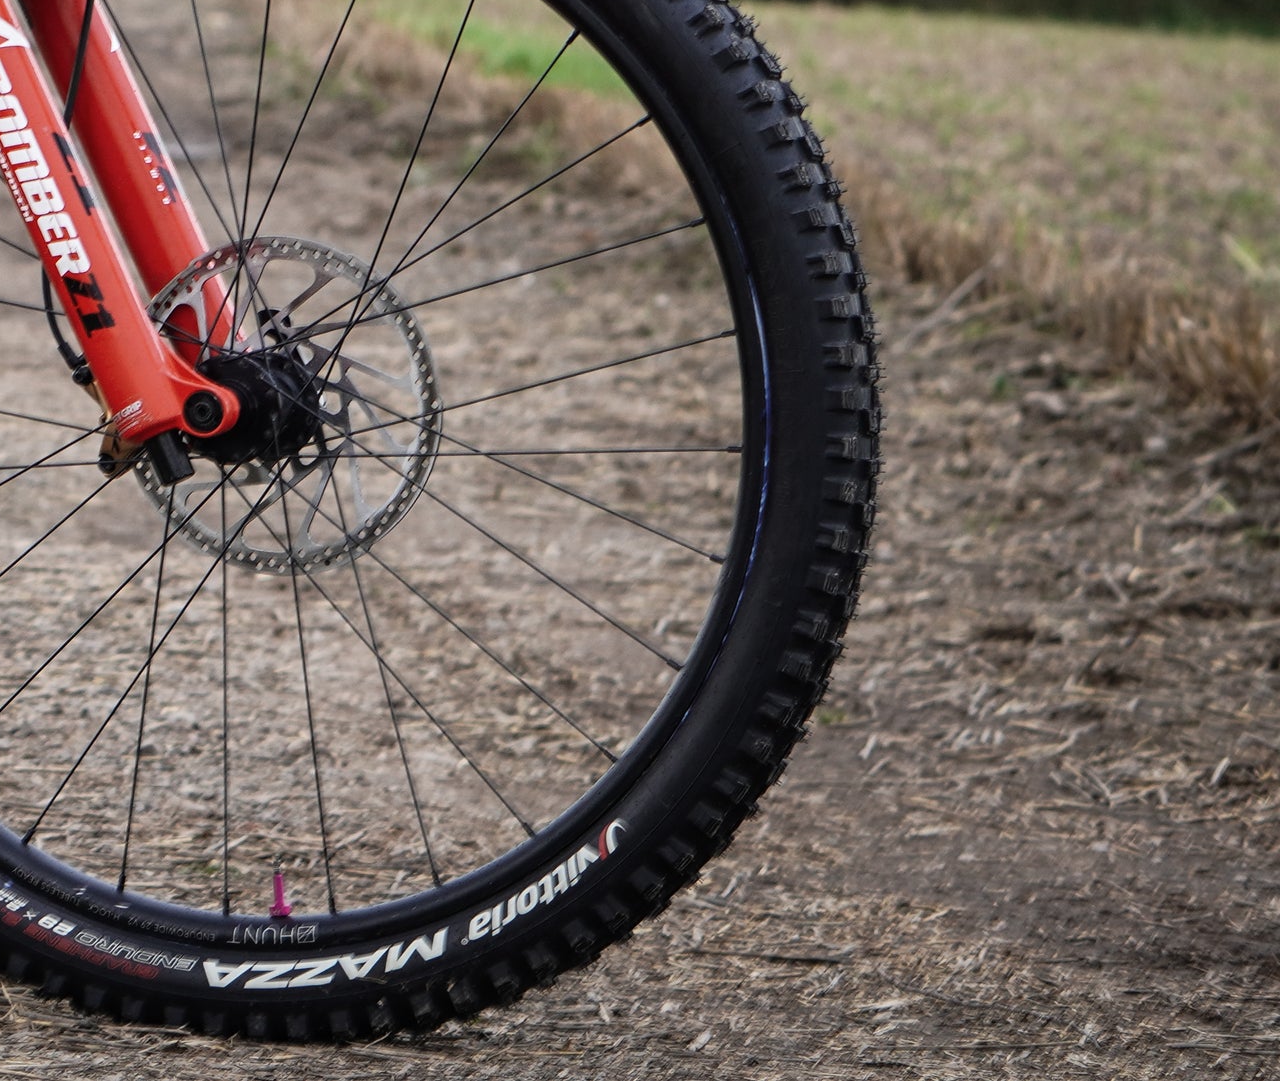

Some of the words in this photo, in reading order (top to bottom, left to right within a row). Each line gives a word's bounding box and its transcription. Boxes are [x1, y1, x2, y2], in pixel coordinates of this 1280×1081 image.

[63, 272, 116, 339] Z1
[37, 912, 78, 936] 29
[226, 922, 297, 945] HUNT
[22, 921, 161, 980] GRAPHENE
[73, 928, 201, 972] ENDURO
[202, 925, 450, 990] MAZZA
